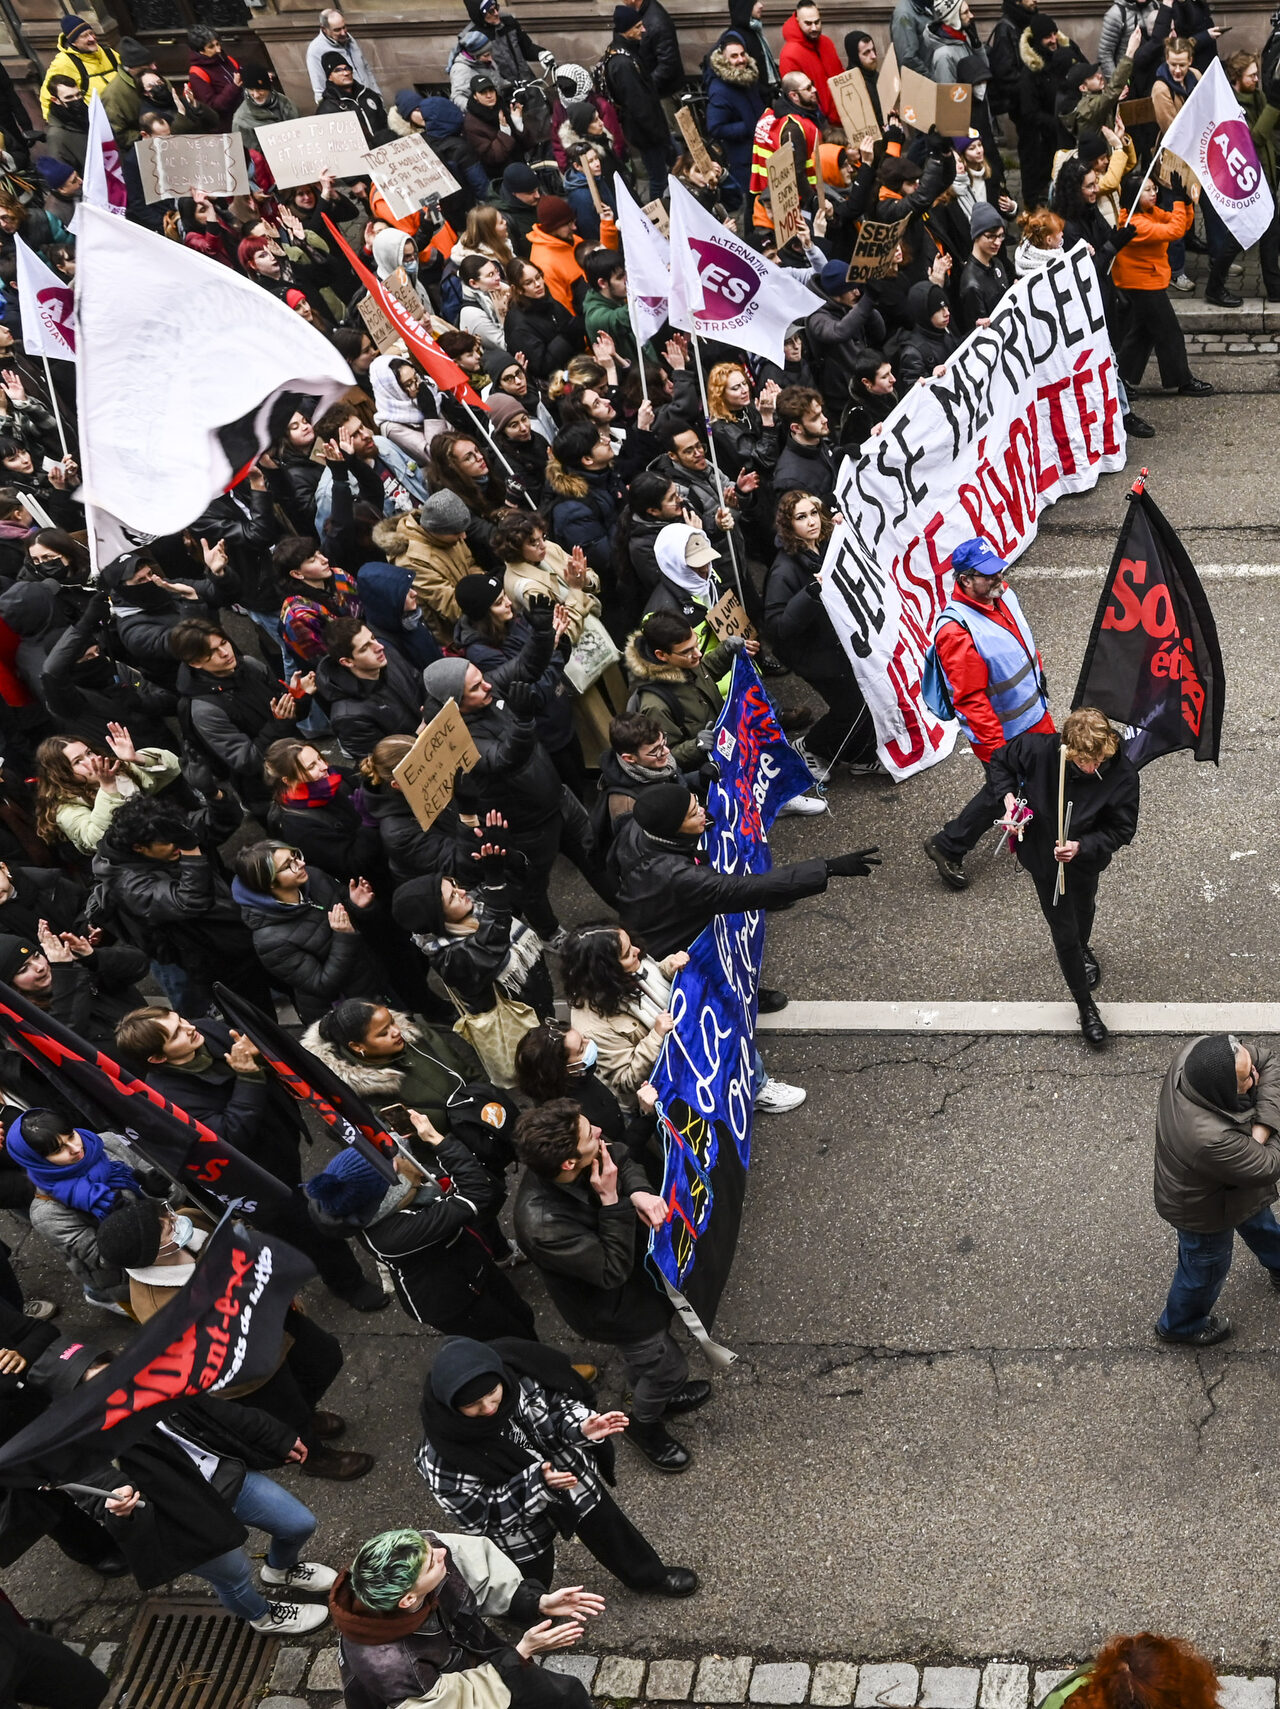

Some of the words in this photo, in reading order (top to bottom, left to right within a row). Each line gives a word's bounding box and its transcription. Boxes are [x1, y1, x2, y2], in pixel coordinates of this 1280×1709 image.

[833, 73, 853, 87] BELLE
[360, 147, 389, 169] TROP
[1213, 132, 1258, 192] AES
[1206, 183, 1261, 210] STRASBOURG
[709, 235, 768, 277] ALTERNATIVE
[695, 300, 759, 331] STRASBOURG
[709, 616, 724, 634] LA
[726, 617, 739, 636] OU
[424, 750, 471, 819] RETRATE
